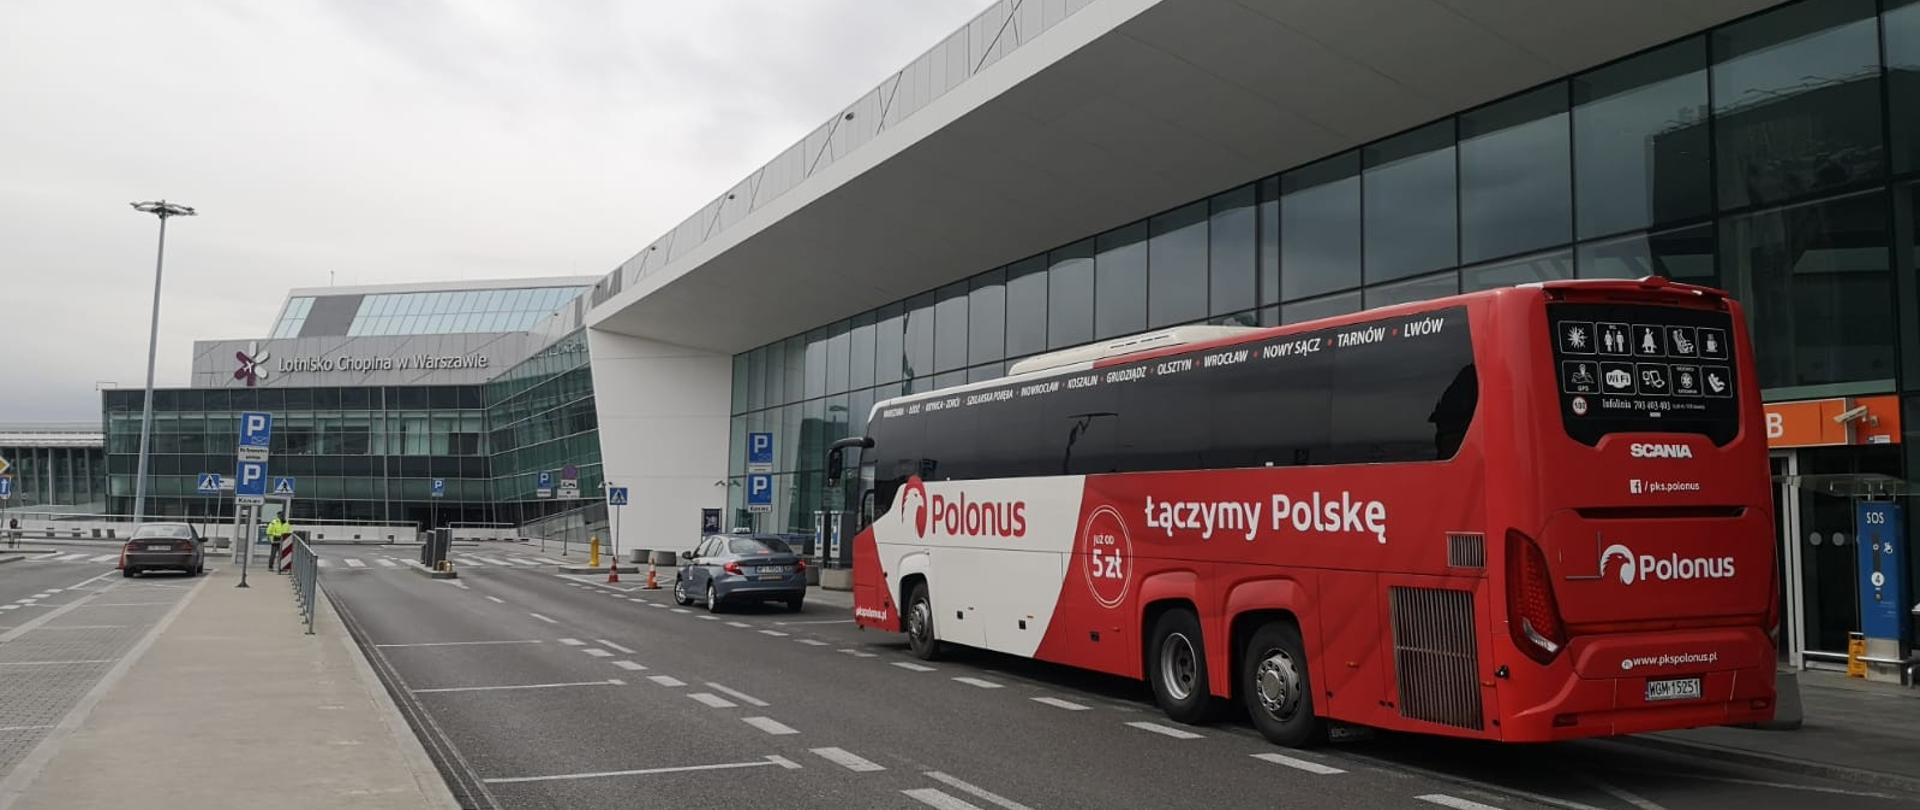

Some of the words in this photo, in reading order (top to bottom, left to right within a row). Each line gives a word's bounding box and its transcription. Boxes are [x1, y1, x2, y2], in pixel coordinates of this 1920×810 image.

[1337, 326, 1386, 347] TARNÓW
[1404, 317, 1444, 338] LWÓW
[1262, 344, 1294, 359] NOWY
[1295, 338, 1321, 357] SĄCZ
[278, 356, 334, 373] Lotnisko
[338, 355, 393, 373] Chopina
[399, 358, 409, 369] w
[413, 353, 488, 369] Warszawie
[1157, 359, 1192, 375] OLSZTYN
[1203, 350, 1249, 368] WROCŁAW
[1067, 375, 1098, 390] KOSZALIN
[1106, 366, 1147, 383] GRUDZIĄDZ
[1602, 398, 1631, 409] Infolinia
[247, 415, 265, 436] P
[1766, 412, 1784, 439] B
[754, 434, 768, 454] P
[1630, 443, 1692, 458] SCANIA
[243, 464, 261, 485] P
[753, 476, 767, 495] P
[1650, 481, 1700, 493] pks.polonus
[931, 491, 1026, 538] Polonus
[1144, 495, 1262, 541] Łączymy
[1271, 491, 1387, 544] Polskę
[1866, 511, 1885, 524] SOS
[1093, 548, 1103, 577] 5
[1105, 548, 1123, 579] zł
[1639, 552, 1735, 581] Polonus
[1632, 652, 1718, 667] www.pkspolonus.pl
[1649, 682, 1669, 696] WGM
[1671, 680, 1698, 695] 15251
